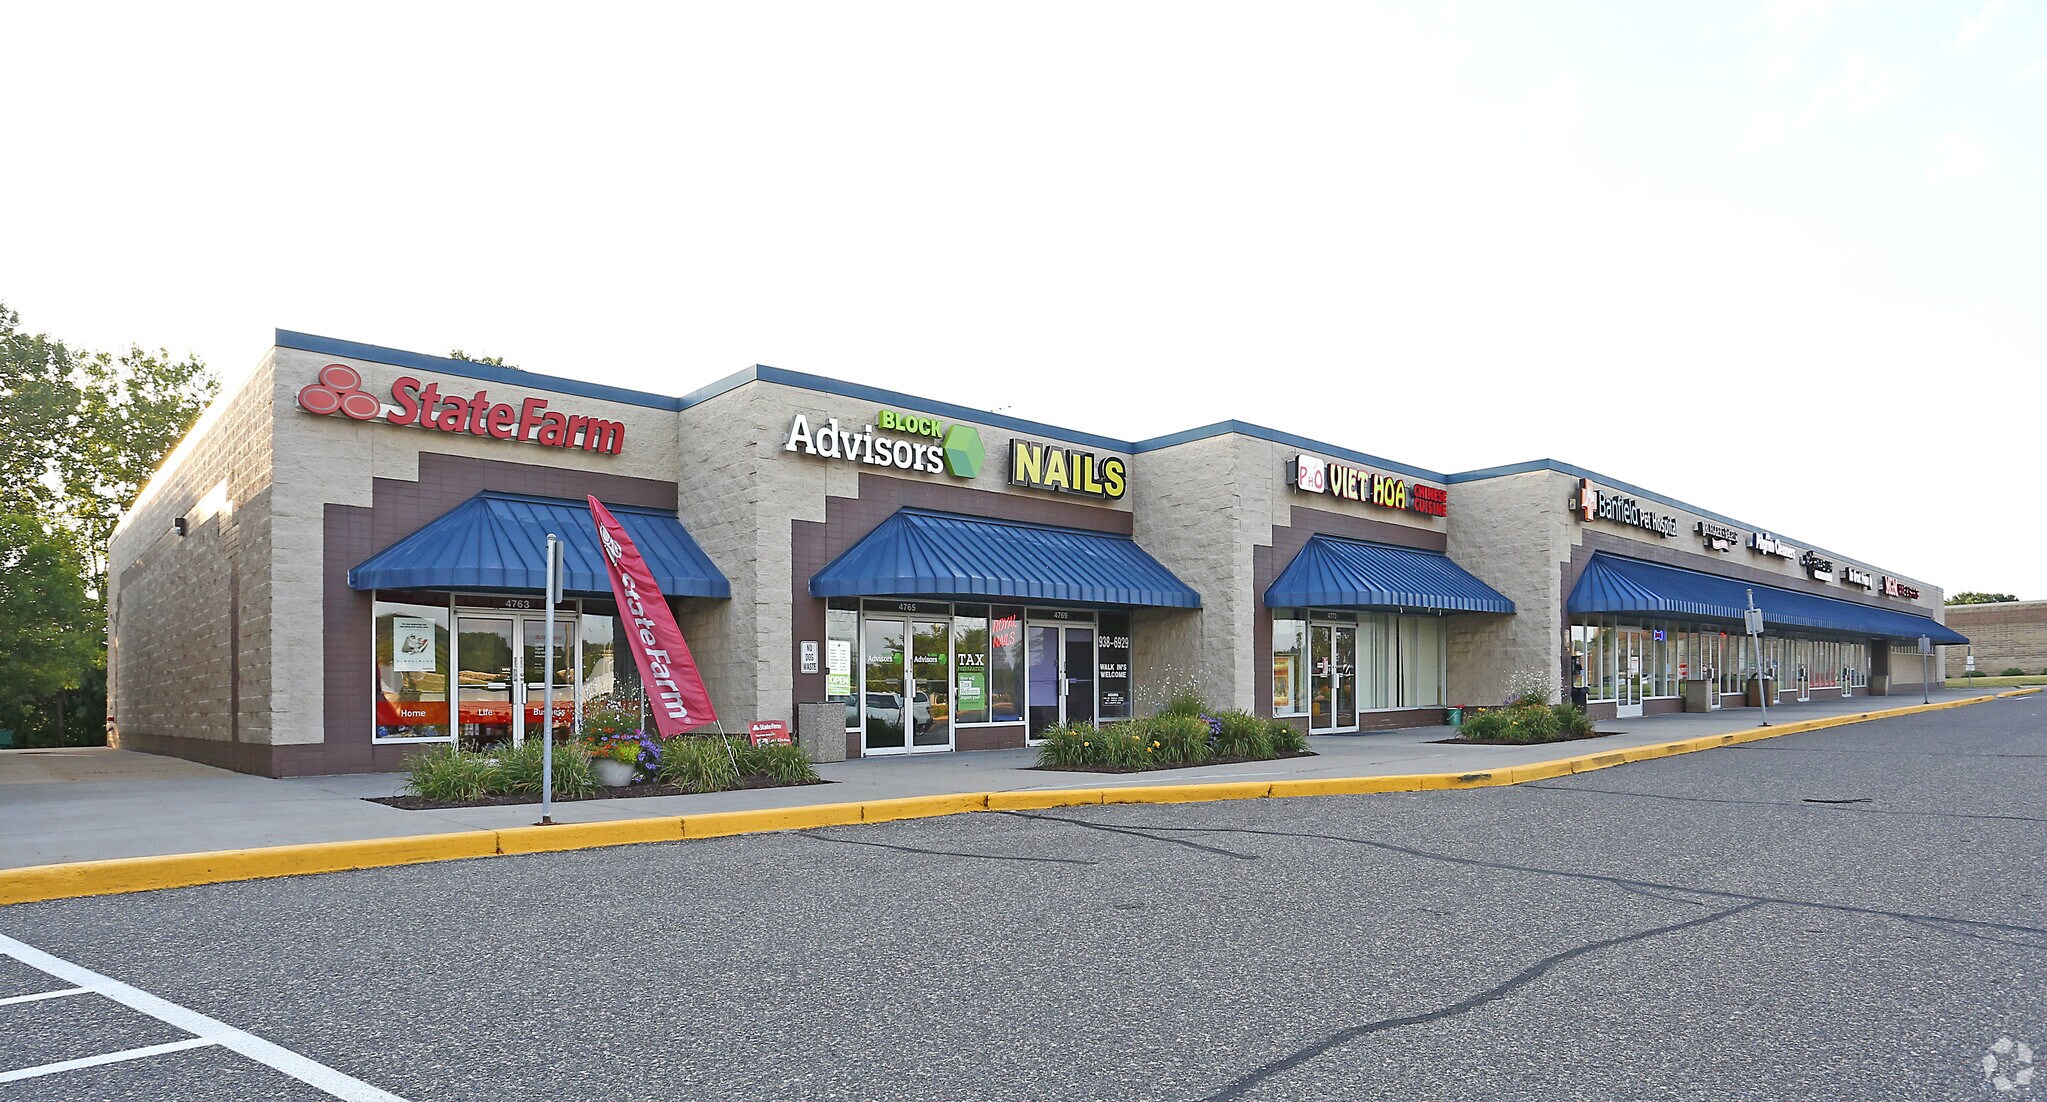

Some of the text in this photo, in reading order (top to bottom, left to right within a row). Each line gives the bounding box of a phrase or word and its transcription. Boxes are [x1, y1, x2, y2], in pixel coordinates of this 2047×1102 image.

[879, 410, 943, 438] BLOCK
[785, 414, 945, 474] Advisors
[1010, 439, 1127, 500] NAILS
[1328, 463, 1406, 510] VIET HOA
[1413, 483, 1447, 503] CHINESE
[1413, 498, 1447, 517] CUISINE
[1599, 490, 1639, 526] Banfield
[1640, 508, 1652, 530] Pet
[1652, 511, 1679, 539] Hospital
[505, 599, 530, 609] 4763
[898, 603, 916, 612] 4765
[1054, 611, 1068, 620] 4769
[993, 615, 1017, 633] ROYAL
[993, 632, 1016, 648] NAILS
[1099, 636, 1129, 649] 938-6929
[806, 644, 813, 652] NO
[805, 653, 815, 662] DOG
[867, 655, 893, 663] Advisors
[958, 653, 984, 666] TAX
[803, 662, 817, 671] WASTE
[1100, 663, 1115, 671] WALK
[830, 675, 849, 684] OPEN
[1100, 671, 1127, 679] WELCOME
[401, 709, 426, 718] Home
[478, 708, 493, 716] Life
